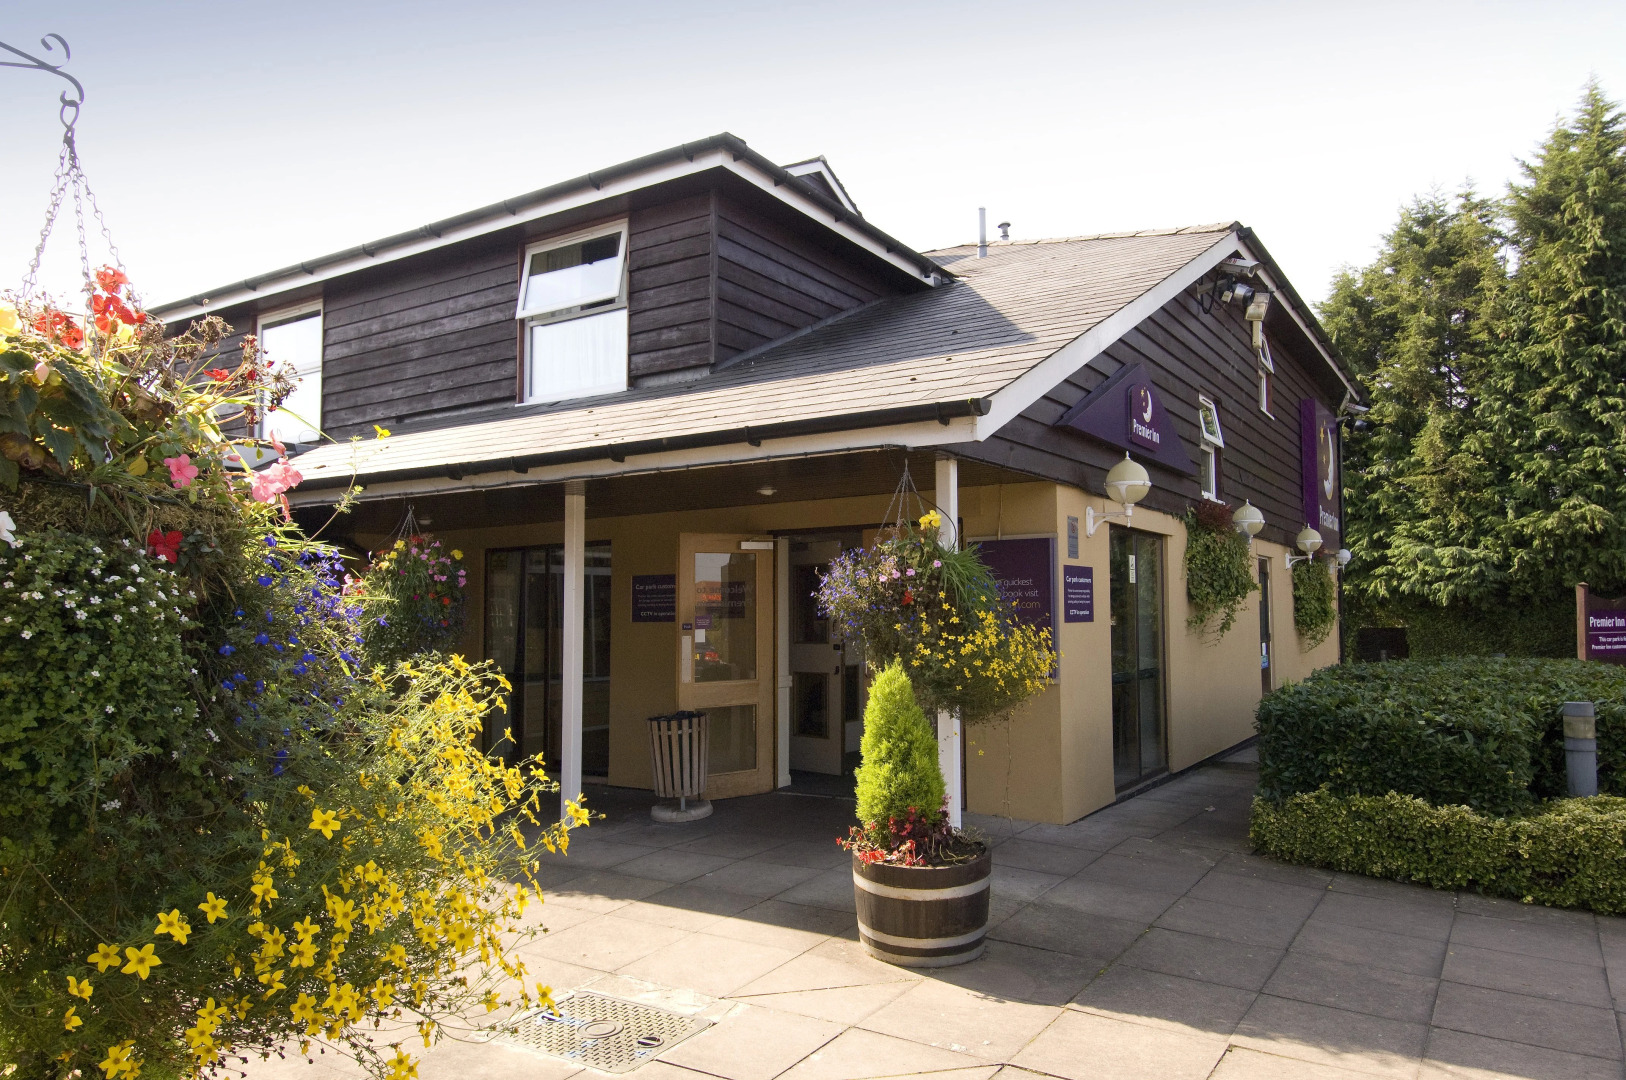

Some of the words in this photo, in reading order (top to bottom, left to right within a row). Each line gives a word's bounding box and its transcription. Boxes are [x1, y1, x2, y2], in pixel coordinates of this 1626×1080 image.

[1133, 418, 1152, 440] Premier
[1152, 428, 1160, 444] Inn
[1319, 504, 1333, 529] Premier
[1003, 577, 1033, 589] quickest
[1024, 588, 1039, 597] visit
[1589, 616, 1614, 627] Premier
[1615, 616, 1626, 627] Inn
